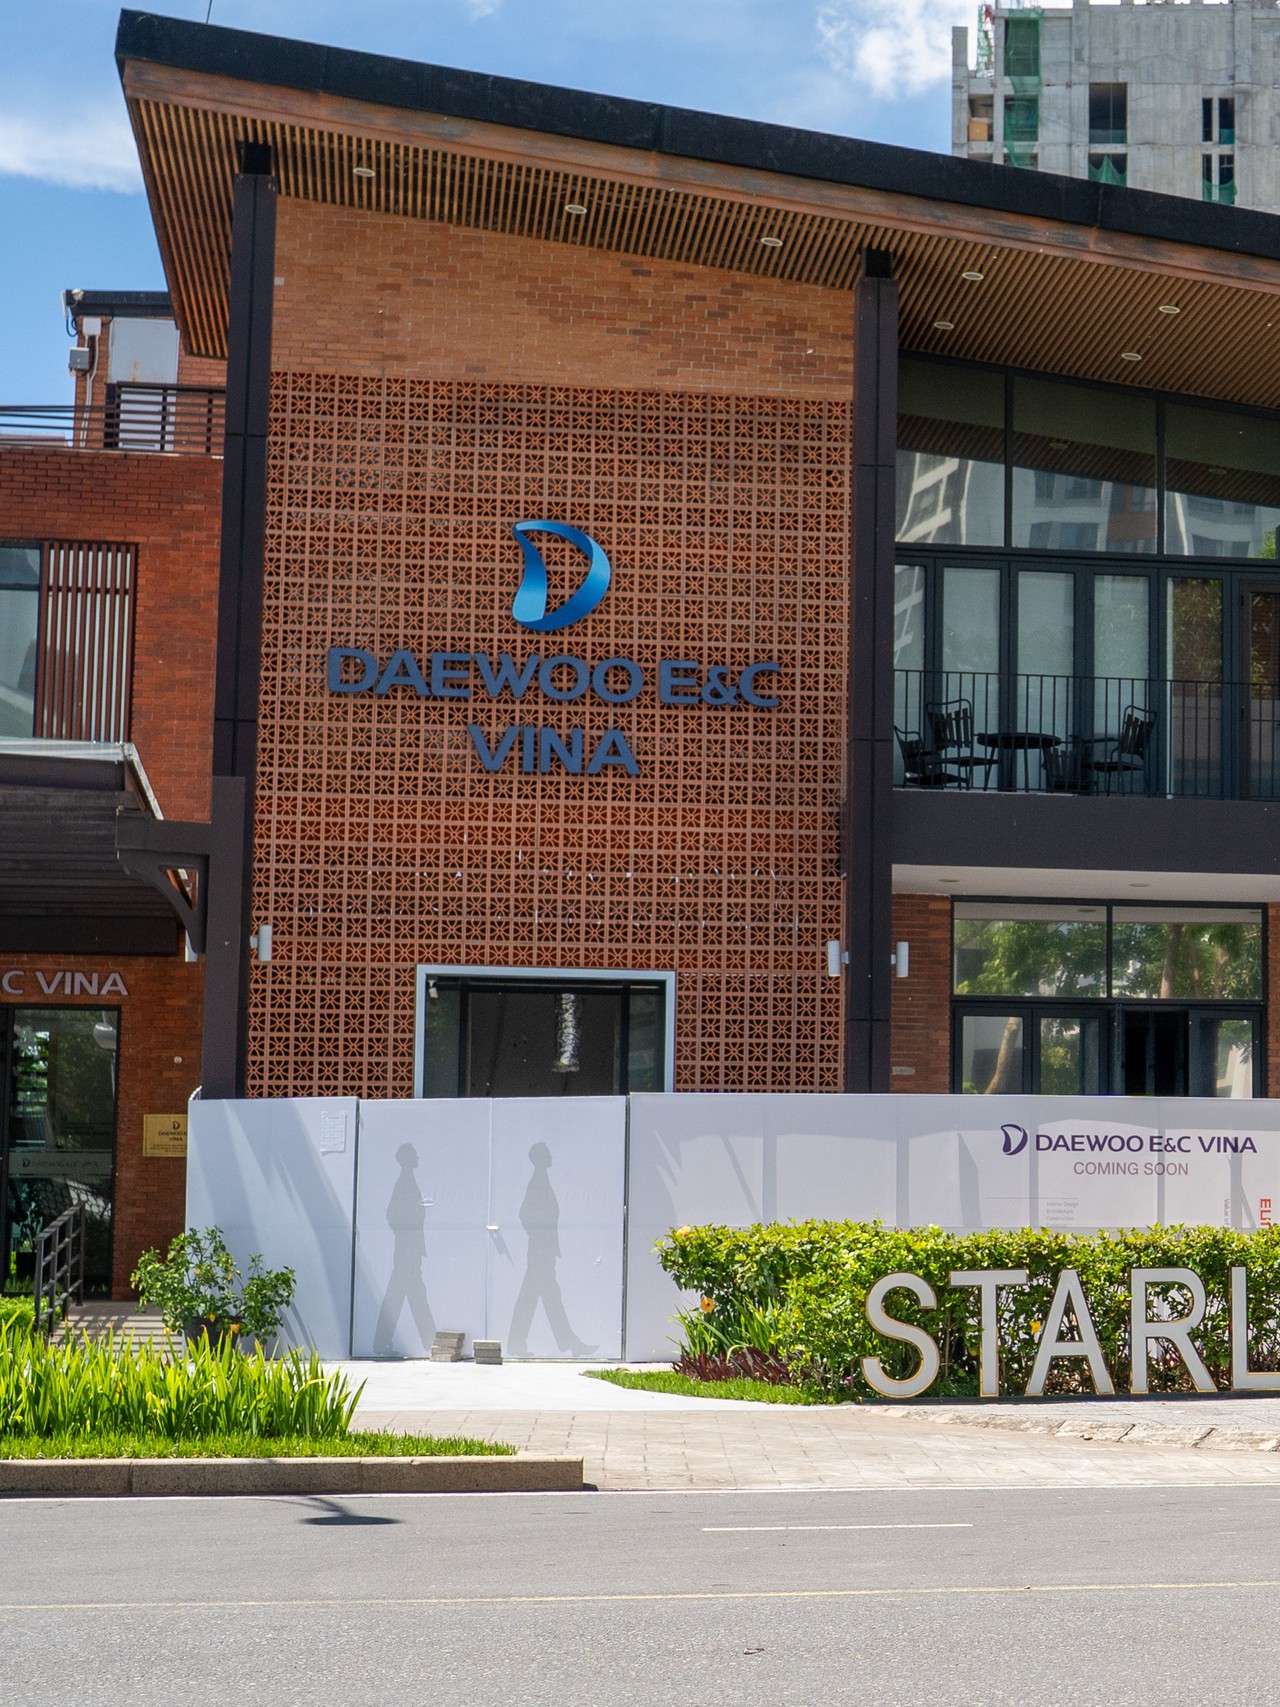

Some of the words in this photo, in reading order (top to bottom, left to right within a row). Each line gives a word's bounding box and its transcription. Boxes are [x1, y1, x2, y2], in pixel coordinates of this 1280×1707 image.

[327, 647, 644, 704] DAEWOO
[659, 660, 781, 708] E&C
[468, 723, 641, 776] VINA
[0, 970, 24, 994] C
[35, 971, 129, 996] VINA
[1036, 1134, 1144, 1152] DAEWOO
[1150, 1135, 1191, 1153] E&C
[1198, 1136, 1258, 1154] VINA
[1073, 1161, 1139, 1176] COMING
[1143, 1162, 1189, 1176] SOON
